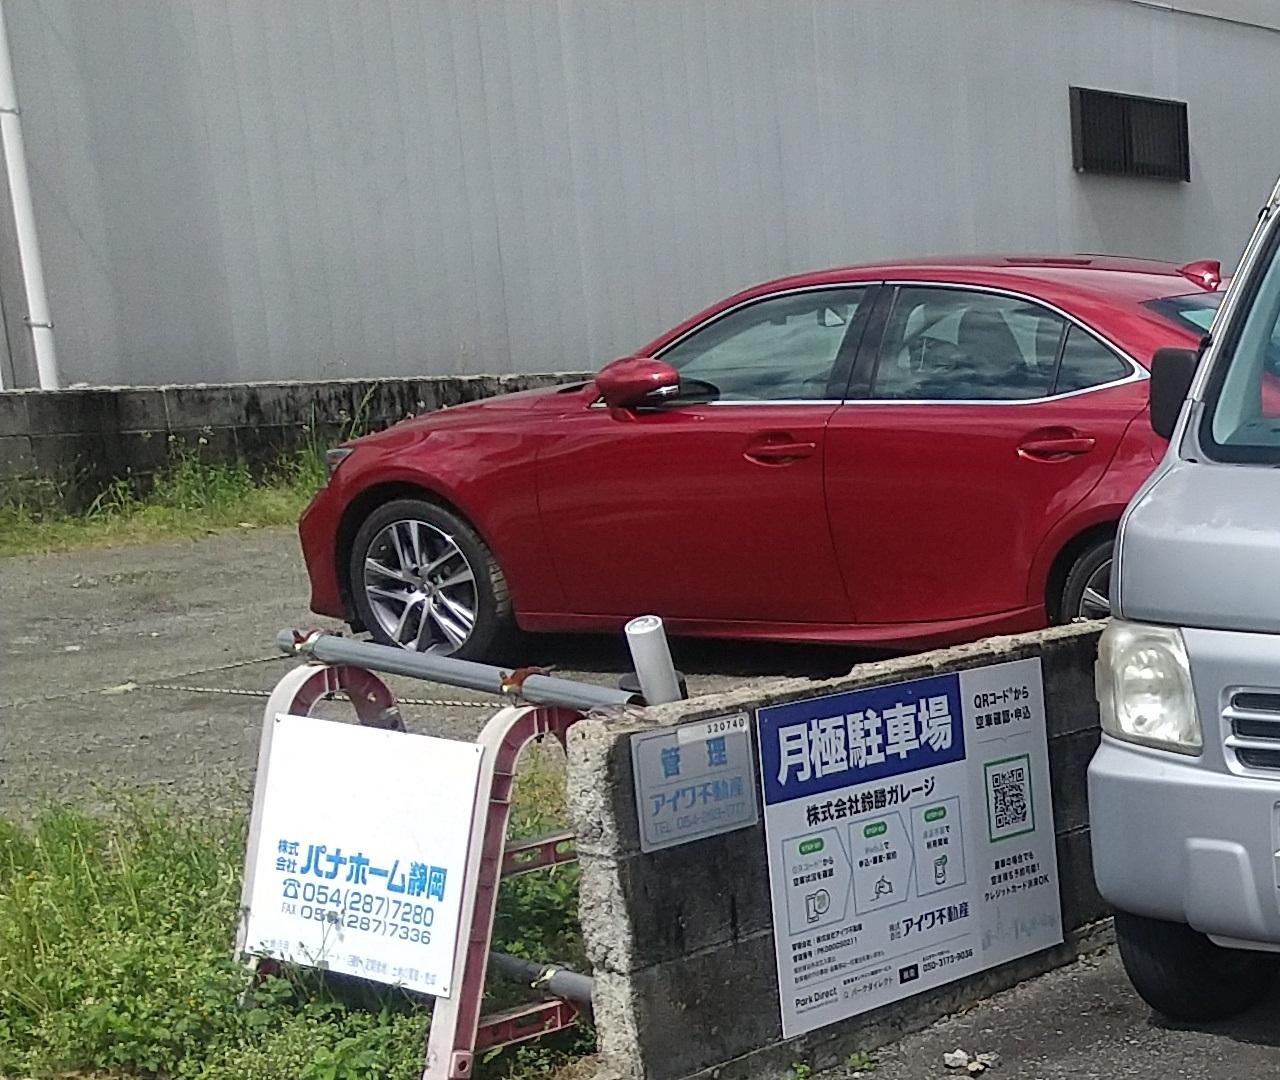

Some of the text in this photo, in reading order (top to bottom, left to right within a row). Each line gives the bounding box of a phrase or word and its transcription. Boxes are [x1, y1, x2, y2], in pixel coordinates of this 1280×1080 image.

[707, 718, 745, 734] 320740
[777, 694, 953, 786] 月極駐車場
[649, 776, 744, 817] アイワ不動産
[300, 844, 448, 903] パナホーム静岡
[281, 902, 432, 945] FAX 05(287)7336
[302, 882, 435, 928] 054(287)7280
[902, 901, 970, 937] アイワ不動産
